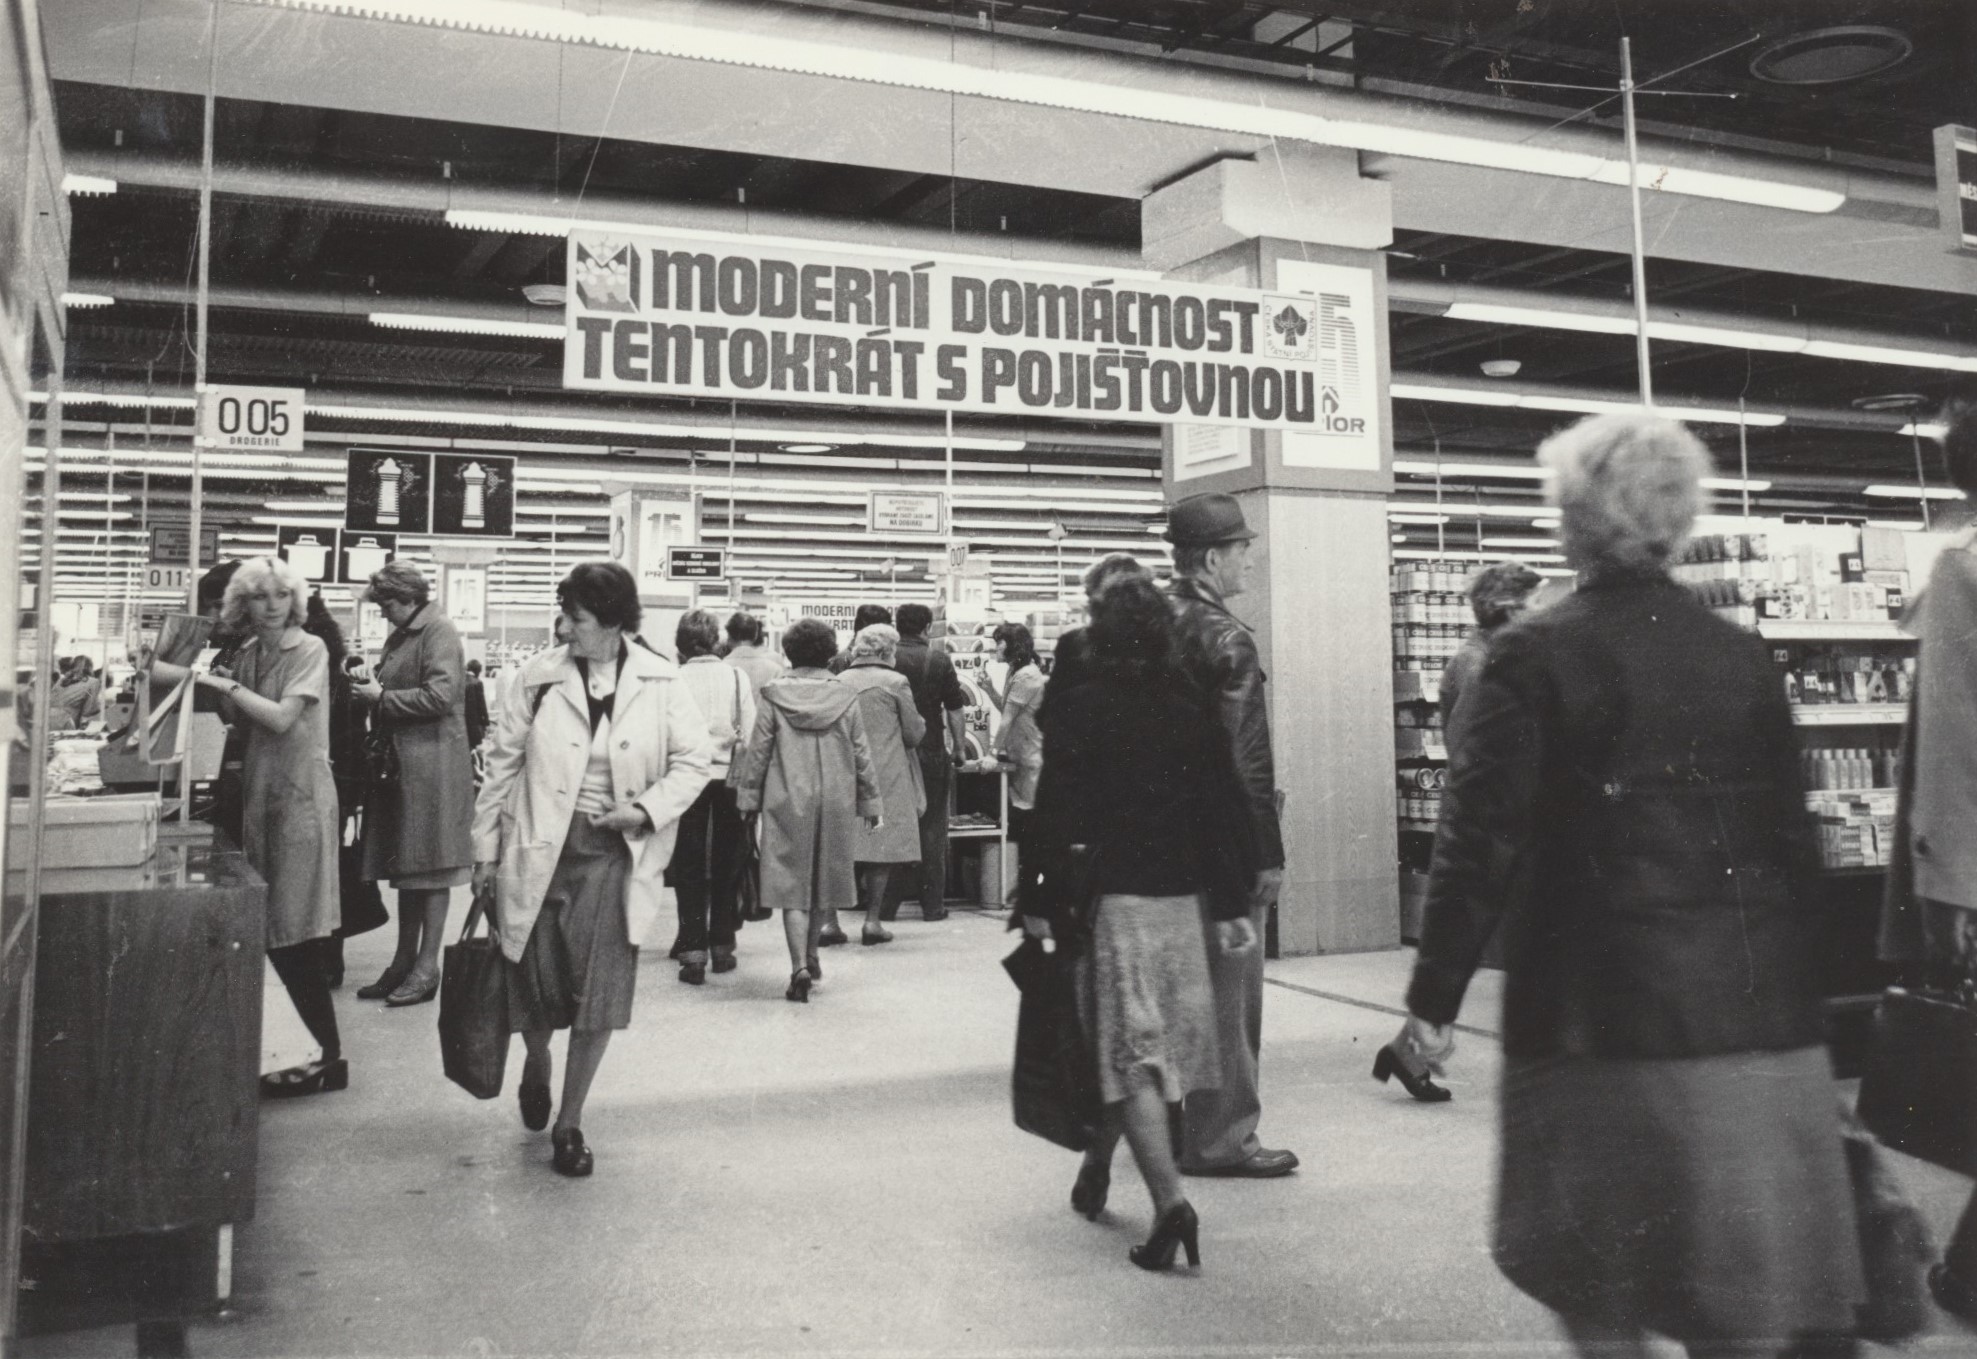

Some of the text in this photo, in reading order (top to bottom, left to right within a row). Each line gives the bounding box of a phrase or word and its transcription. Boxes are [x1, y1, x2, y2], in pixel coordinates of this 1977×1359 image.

[651, 248, 1260, 354] MODERNÍ DOMÁCNOST
[576, 317, 1315, 423] TENTOKRÁT S POJIŠŤOVNOU
[229, 436, 281, 446] DROGERIE
[150, 569, 183, 586] 011
